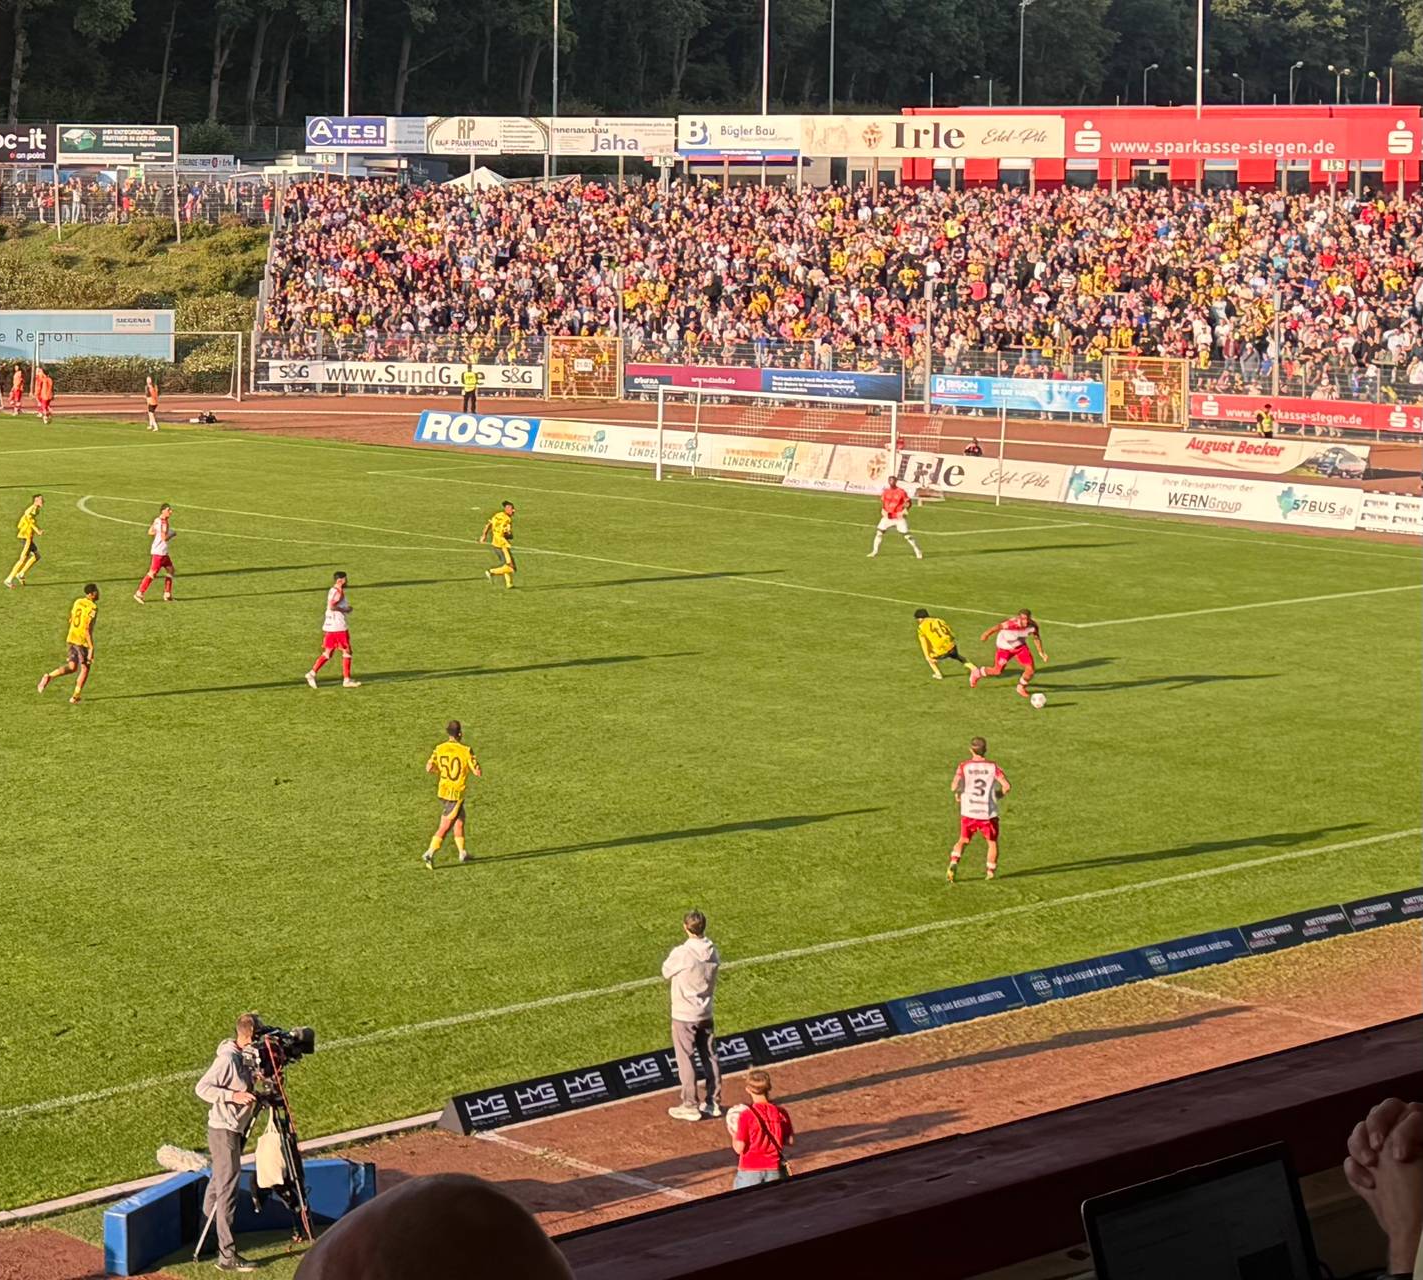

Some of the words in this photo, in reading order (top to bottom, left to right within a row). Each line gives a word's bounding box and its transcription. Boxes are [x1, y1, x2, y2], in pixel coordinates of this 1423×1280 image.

[311, 120, 385, 139] ATESI
[457, 118, 476, 139] RP
[720, 123, 753, 138] Bügler
[755, 124, 776, 136] Bau
[891, 121, 965, 149] Irle
[26, 151, 46, 160] point
[1110, 139, 1336, 158] www.sparkasse-siegen.de
[279, 363, 310, 379] S&G
[501, 367, 533, 385] S&G
[421, 411, 532, 449] ROSS
[1185, 436, 1236, 455] August
[1236, 440, 1286, 458] Becker
[896, 453, 966, 487] Irle
[1239, 483, 1255, 493] der
[1167, 491, 1243, 513] WERNGroup
[73, 608, 82, 628] 8
[439, 754, 462, 782] 50
[972, 778, 987, 797] 3
[761, 1026, 801, 1049] HMG
[805, 1017, 843, 1039] HMG
[847, 1008, 885, 1030] HMG
[464, 1093, 508, 1119] HMG
[514, 1082, 557, 1109] HMG
[562, 1070, 605, 1097] HMG
[618, 1057, 661, 1083] HMG
